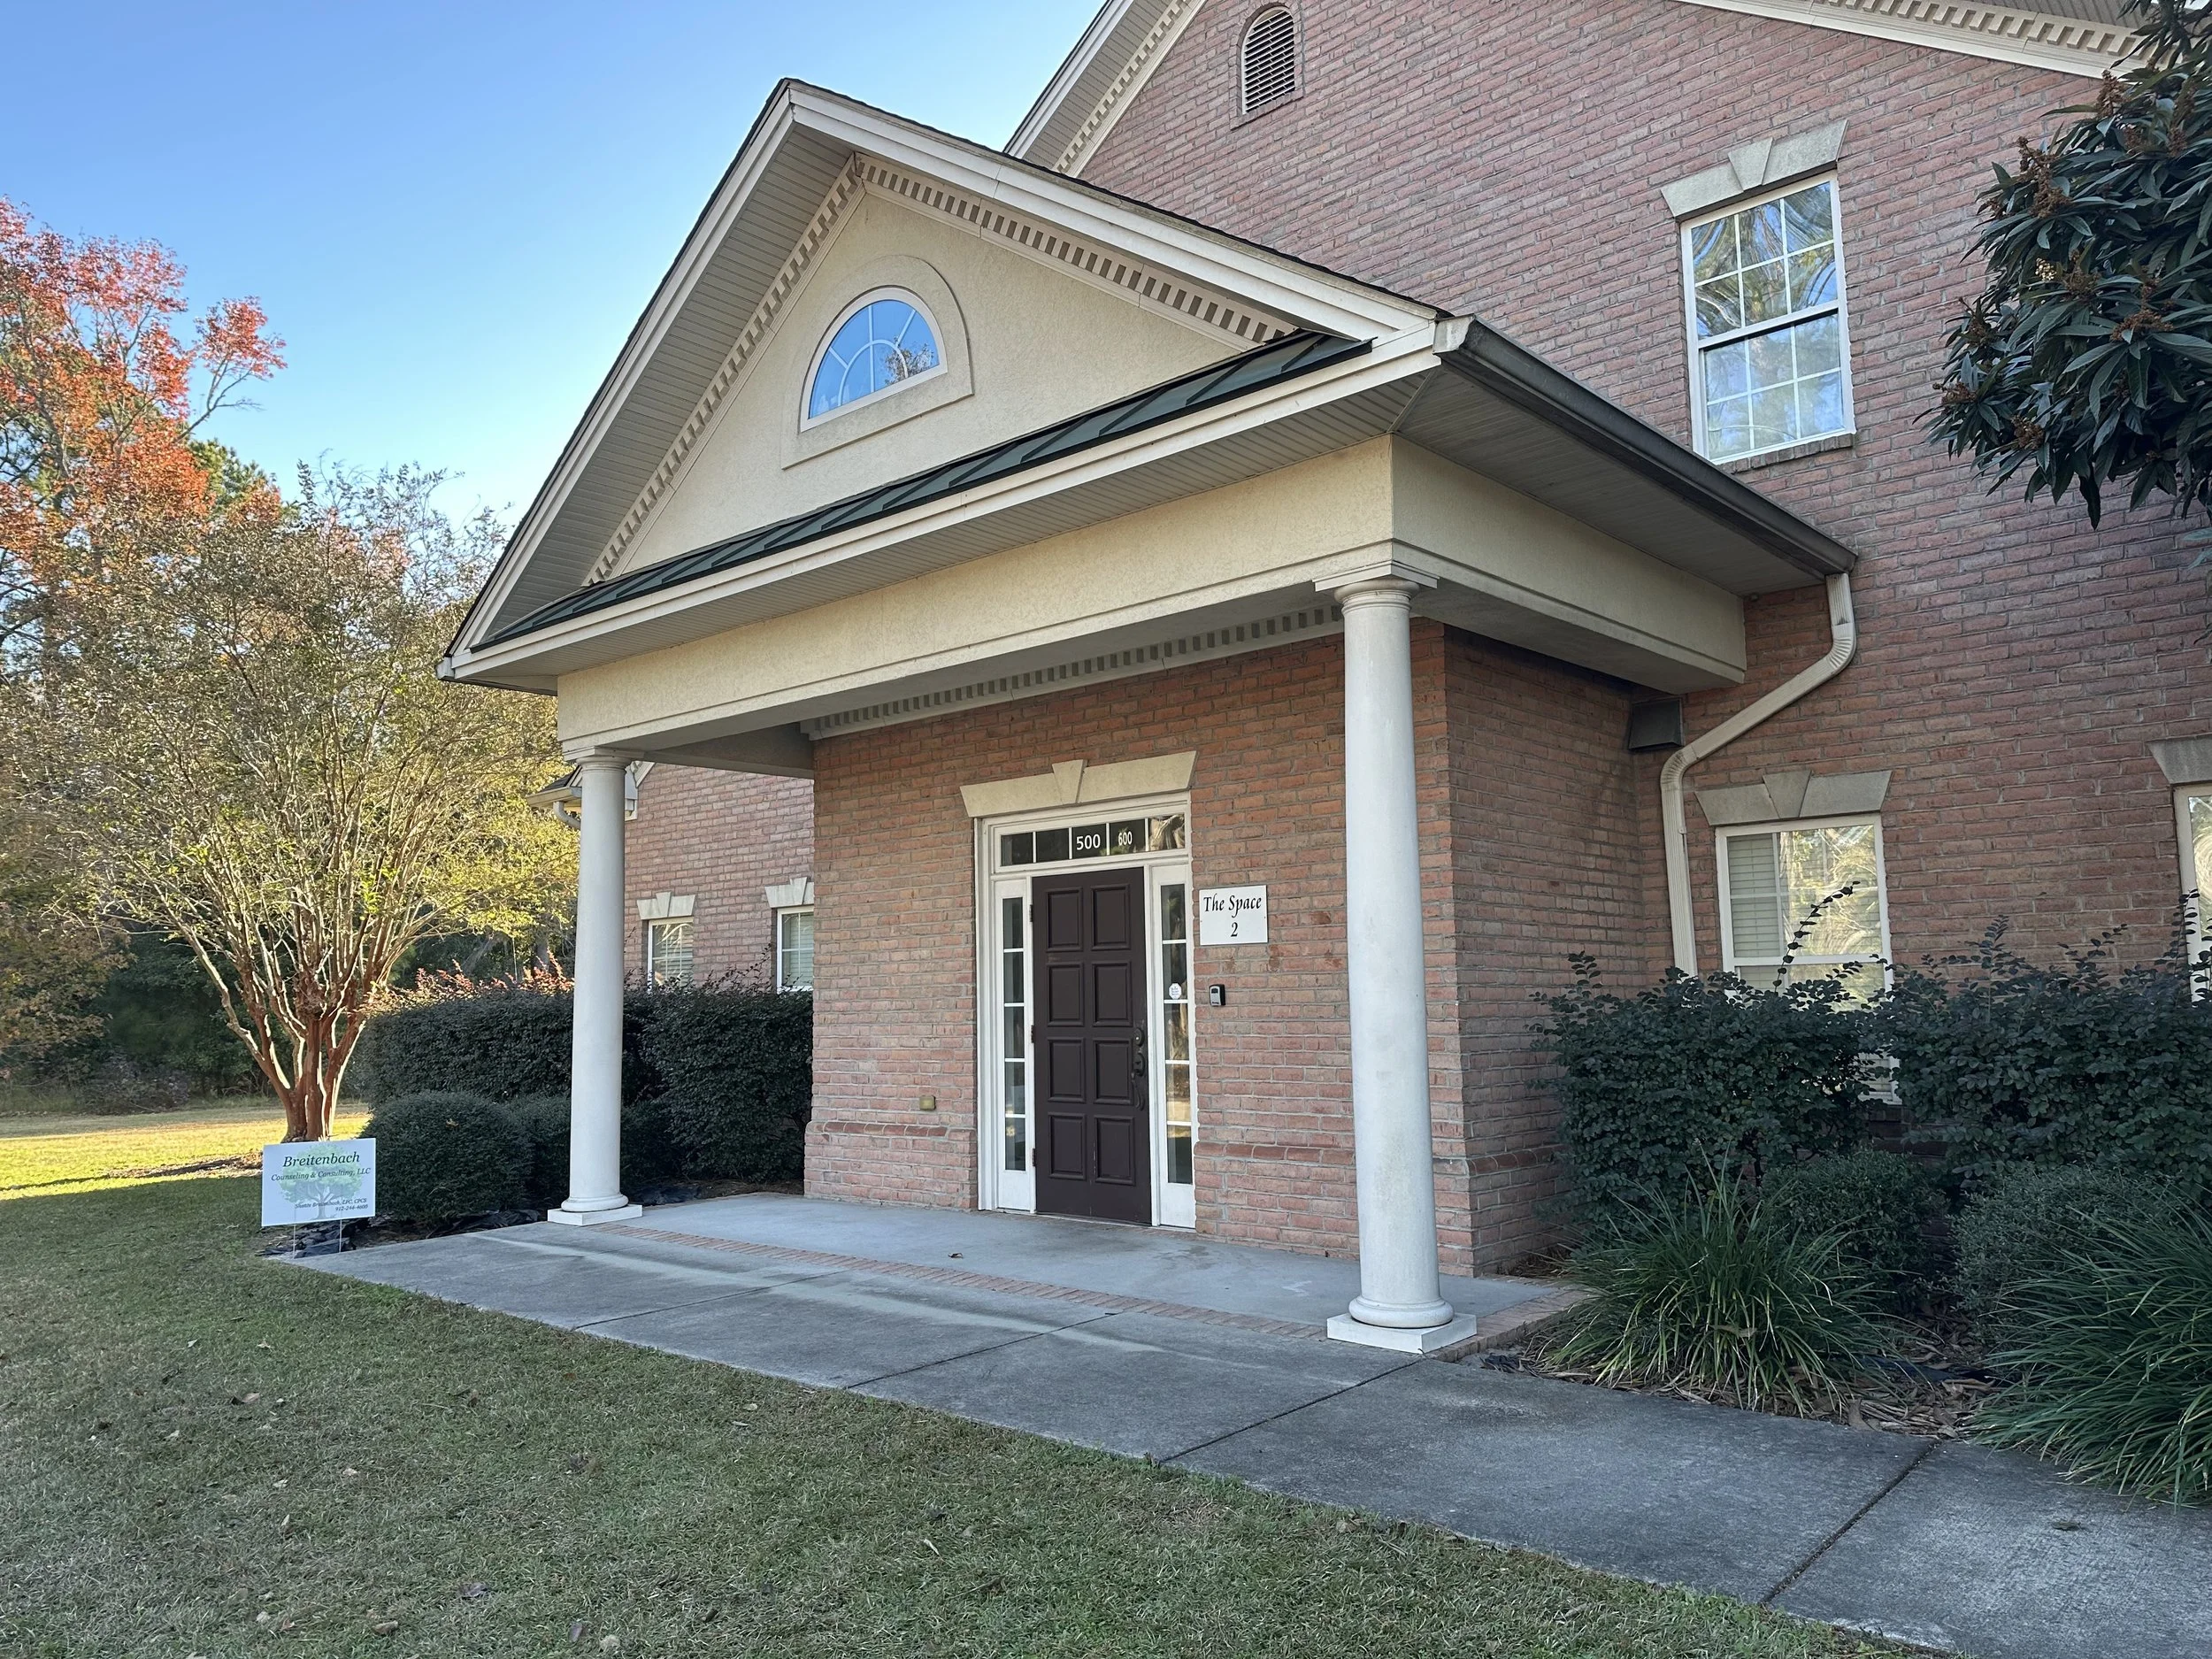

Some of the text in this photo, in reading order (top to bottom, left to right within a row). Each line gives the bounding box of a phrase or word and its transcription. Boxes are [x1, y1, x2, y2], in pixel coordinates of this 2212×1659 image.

[1076, 833, 1101, 850] 500
[1118, 830, 1133, 846] 600
[1203, 893, 1262, 918] The Space
[1231, 922, 1238, 938] 2
[283, 1151, 360, 1167] Breitenbach
[271, 1171, 309, 1181] Counseling
[318, 1169, 356, 1179] Consulting,
